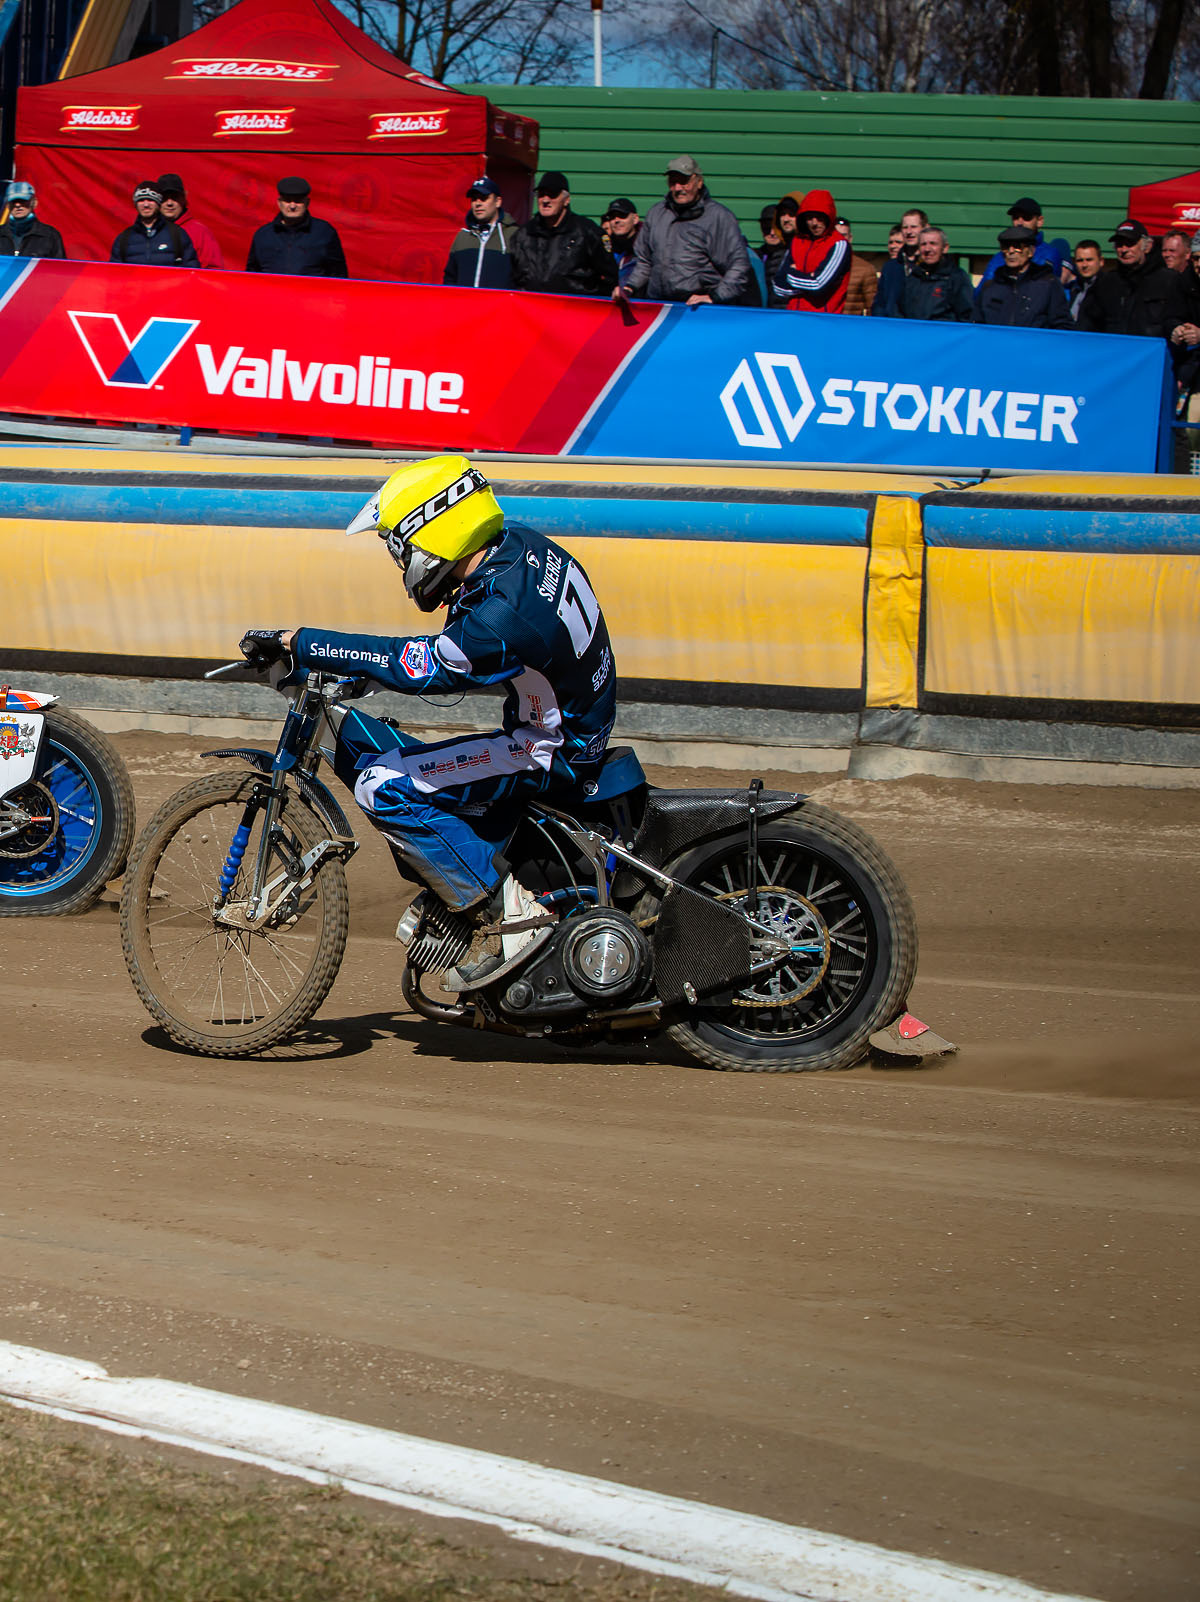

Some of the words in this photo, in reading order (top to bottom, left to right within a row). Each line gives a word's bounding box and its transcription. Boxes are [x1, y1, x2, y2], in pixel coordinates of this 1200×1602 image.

[183, 62, 319, 79] Aldaris
[67, 110, 136, 128] Aldaris
[221, 114, 288, 132] Aldaris
[376, 116, 444, 134] Aldaris
[196, 343, 464, 413] Valvoline
[817, 378, 1079, 444] STOKKER
[537, 548, 562, 602] ŚWIERCZ
[309, 642, 390, 668] Saletromag
[418, 759, 456, 778] Wes
[456, 749, 492, 770] Bud
